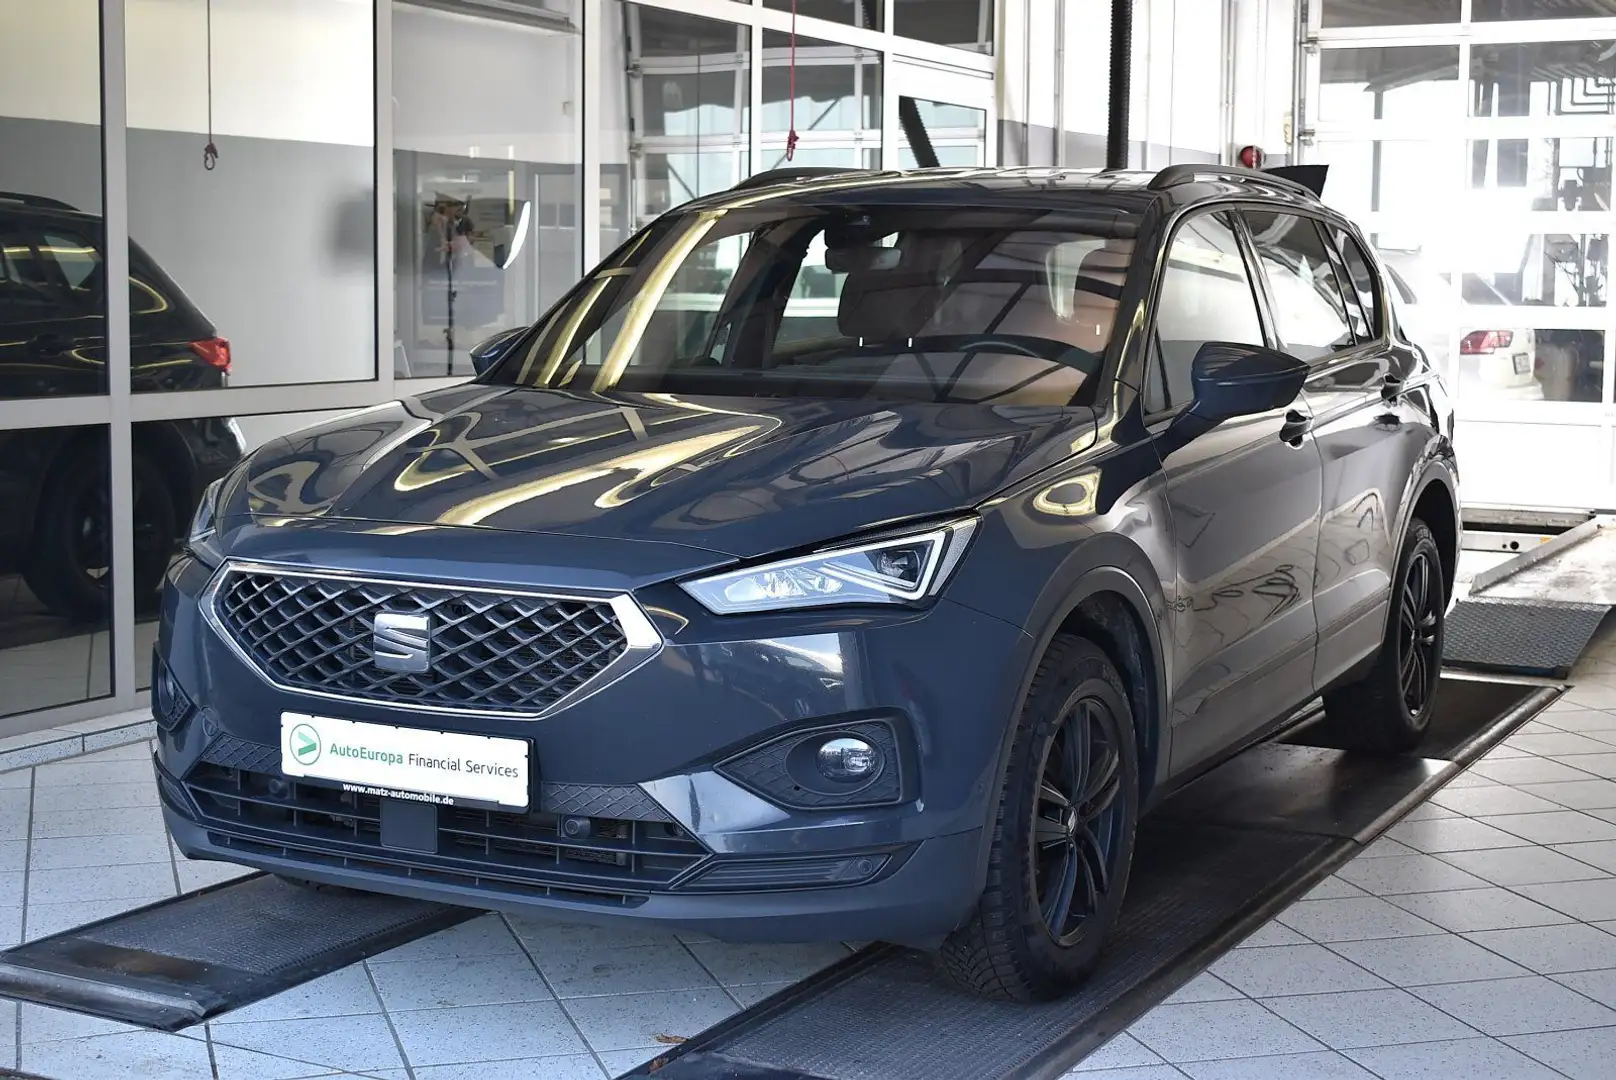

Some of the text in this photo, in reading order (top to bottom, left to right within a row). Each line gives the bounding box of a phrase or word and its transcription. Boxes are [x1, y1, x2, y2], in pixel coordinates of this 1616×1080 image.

[330, 743, 519, 779] AutoEuropa Financial Services
[342, 783, 454, 806] www.matz-automobile.de
